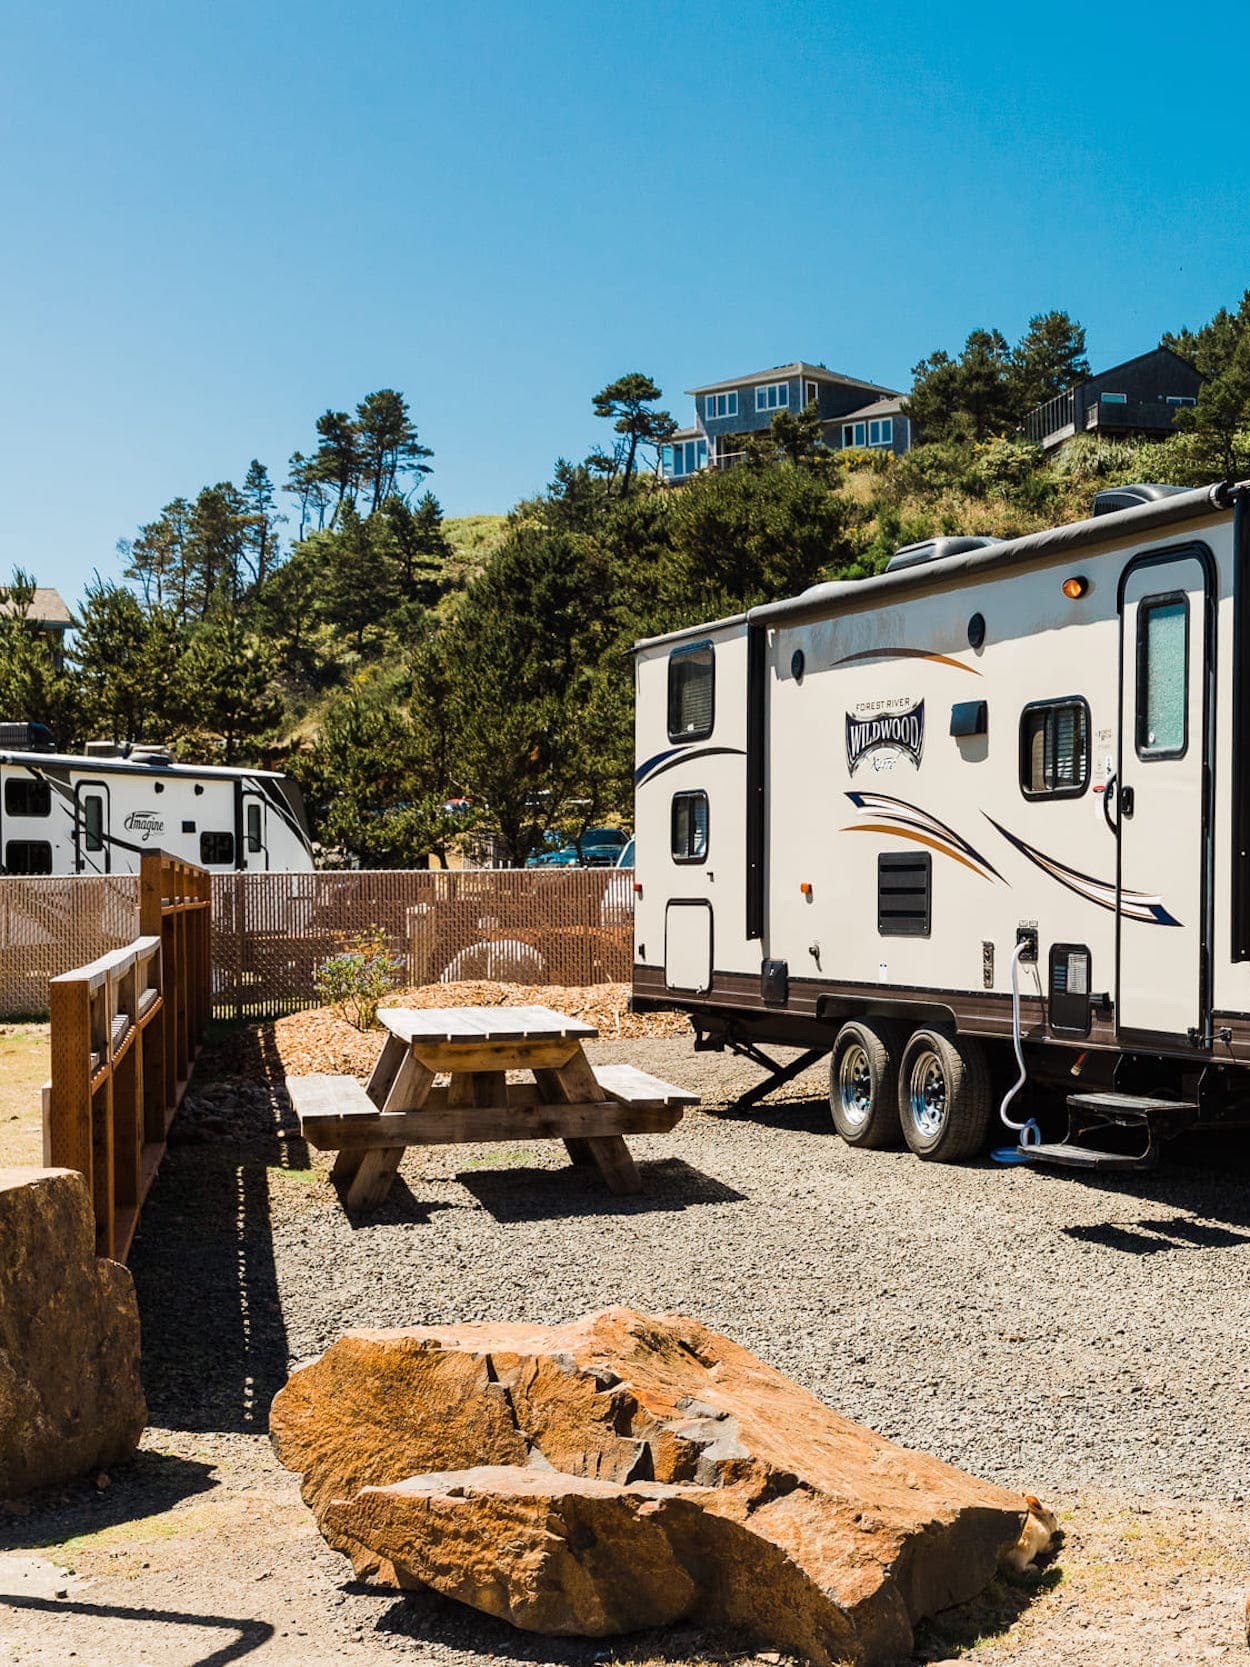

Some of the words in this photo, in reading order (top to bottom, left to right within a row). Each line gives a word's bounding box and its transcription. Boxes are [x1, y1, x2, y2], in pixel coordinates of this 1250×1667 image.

[856, 700, 885, 711] FOREST
[886, 697, 910, 708] RIVER
[850, 716, 919, 758] WILDWOOD
[124, 811, 164, 842] Imagine
